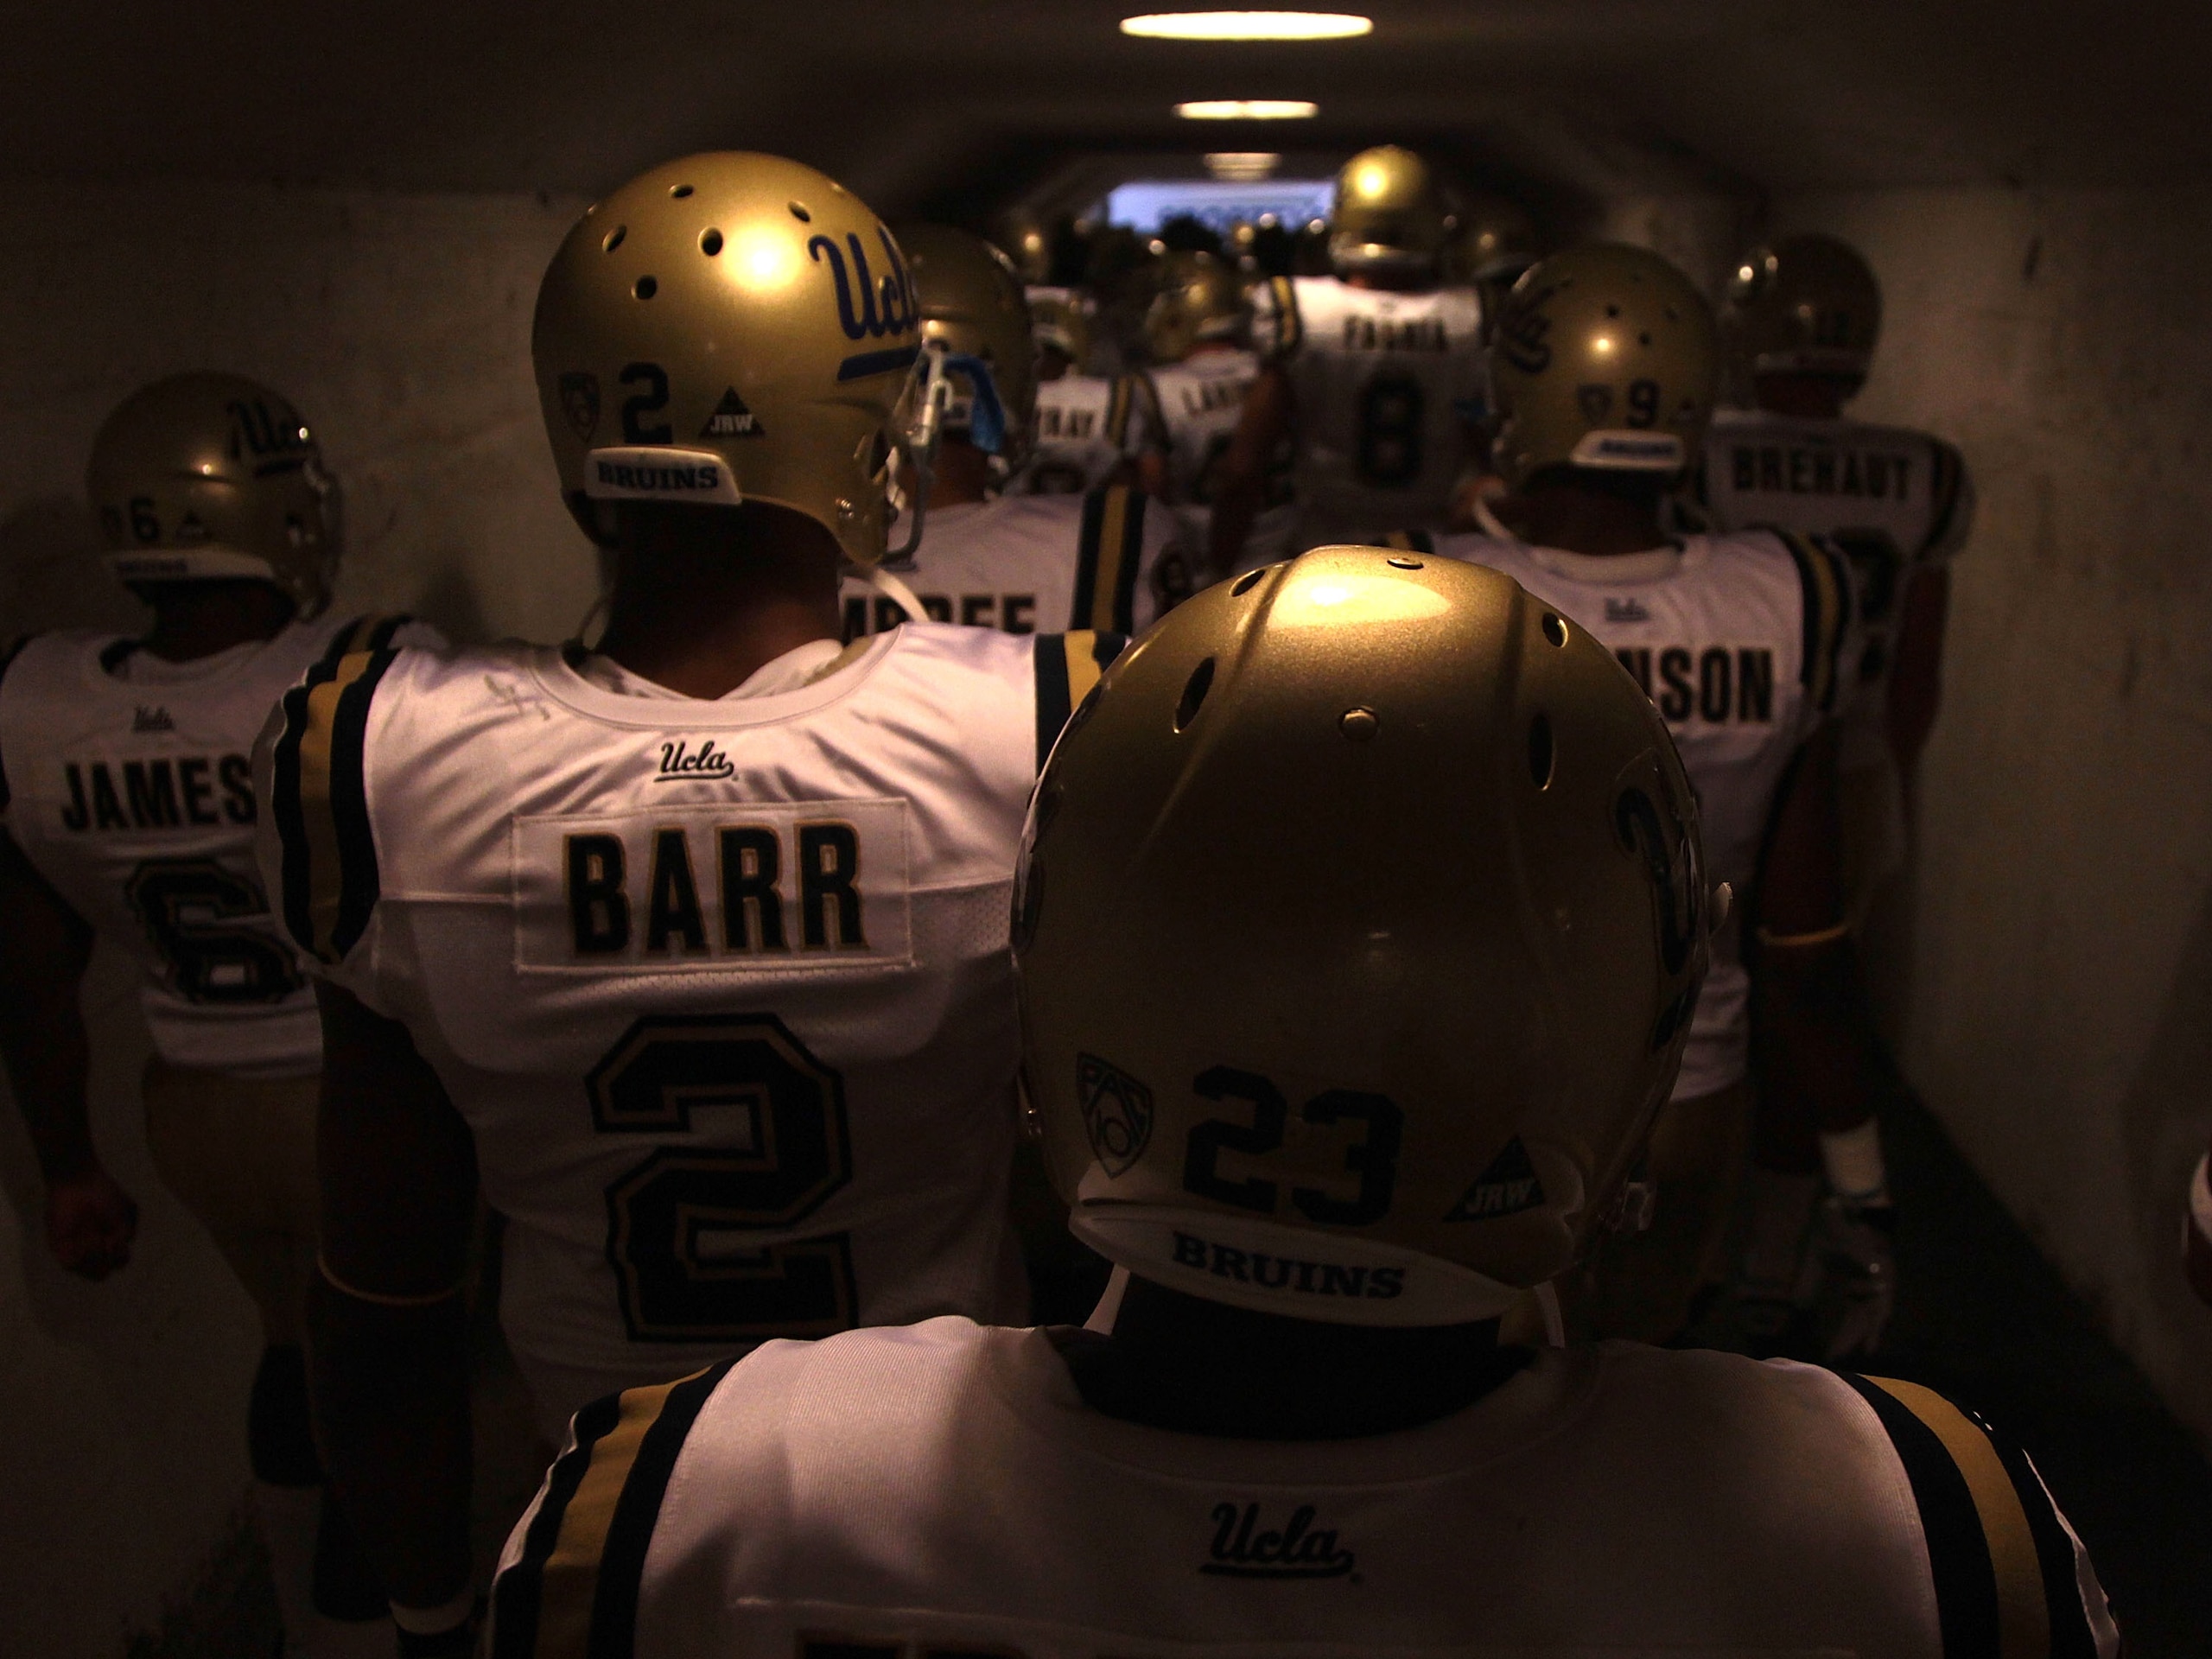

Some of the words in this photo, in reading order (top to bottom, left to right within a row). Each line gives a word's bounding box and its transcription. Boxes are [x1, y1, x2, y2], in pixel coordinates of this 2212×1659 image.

[809, 220, 923, 382] Ucl
[620, 363, 673, 443] 2
[709, 413, 753, 434] JRW
[1357, 372, 1425, 488] 8
[1628, 380, 1658, 429] 9
[597, 461, 718, 491] BRUINS
[1733, 446, 1909, 499] BREHAUT
[131, 498, 159, 541] 6
[62, 754, 257, 831] JAMES
[654, 741, 734, 783] Ucla
[563, 817, 869, 956] BARR
[124, 858, 303, 1005] 6
[585, 1013, 860, 1342] 2
[1183, 1065, 1405, 1227] 23
[1467, 1179, 1533, 1214] JRW
[1173, 1231, 1404, 1299] BRUINS
[1199, 1503, 1356, 1580] Ucla
